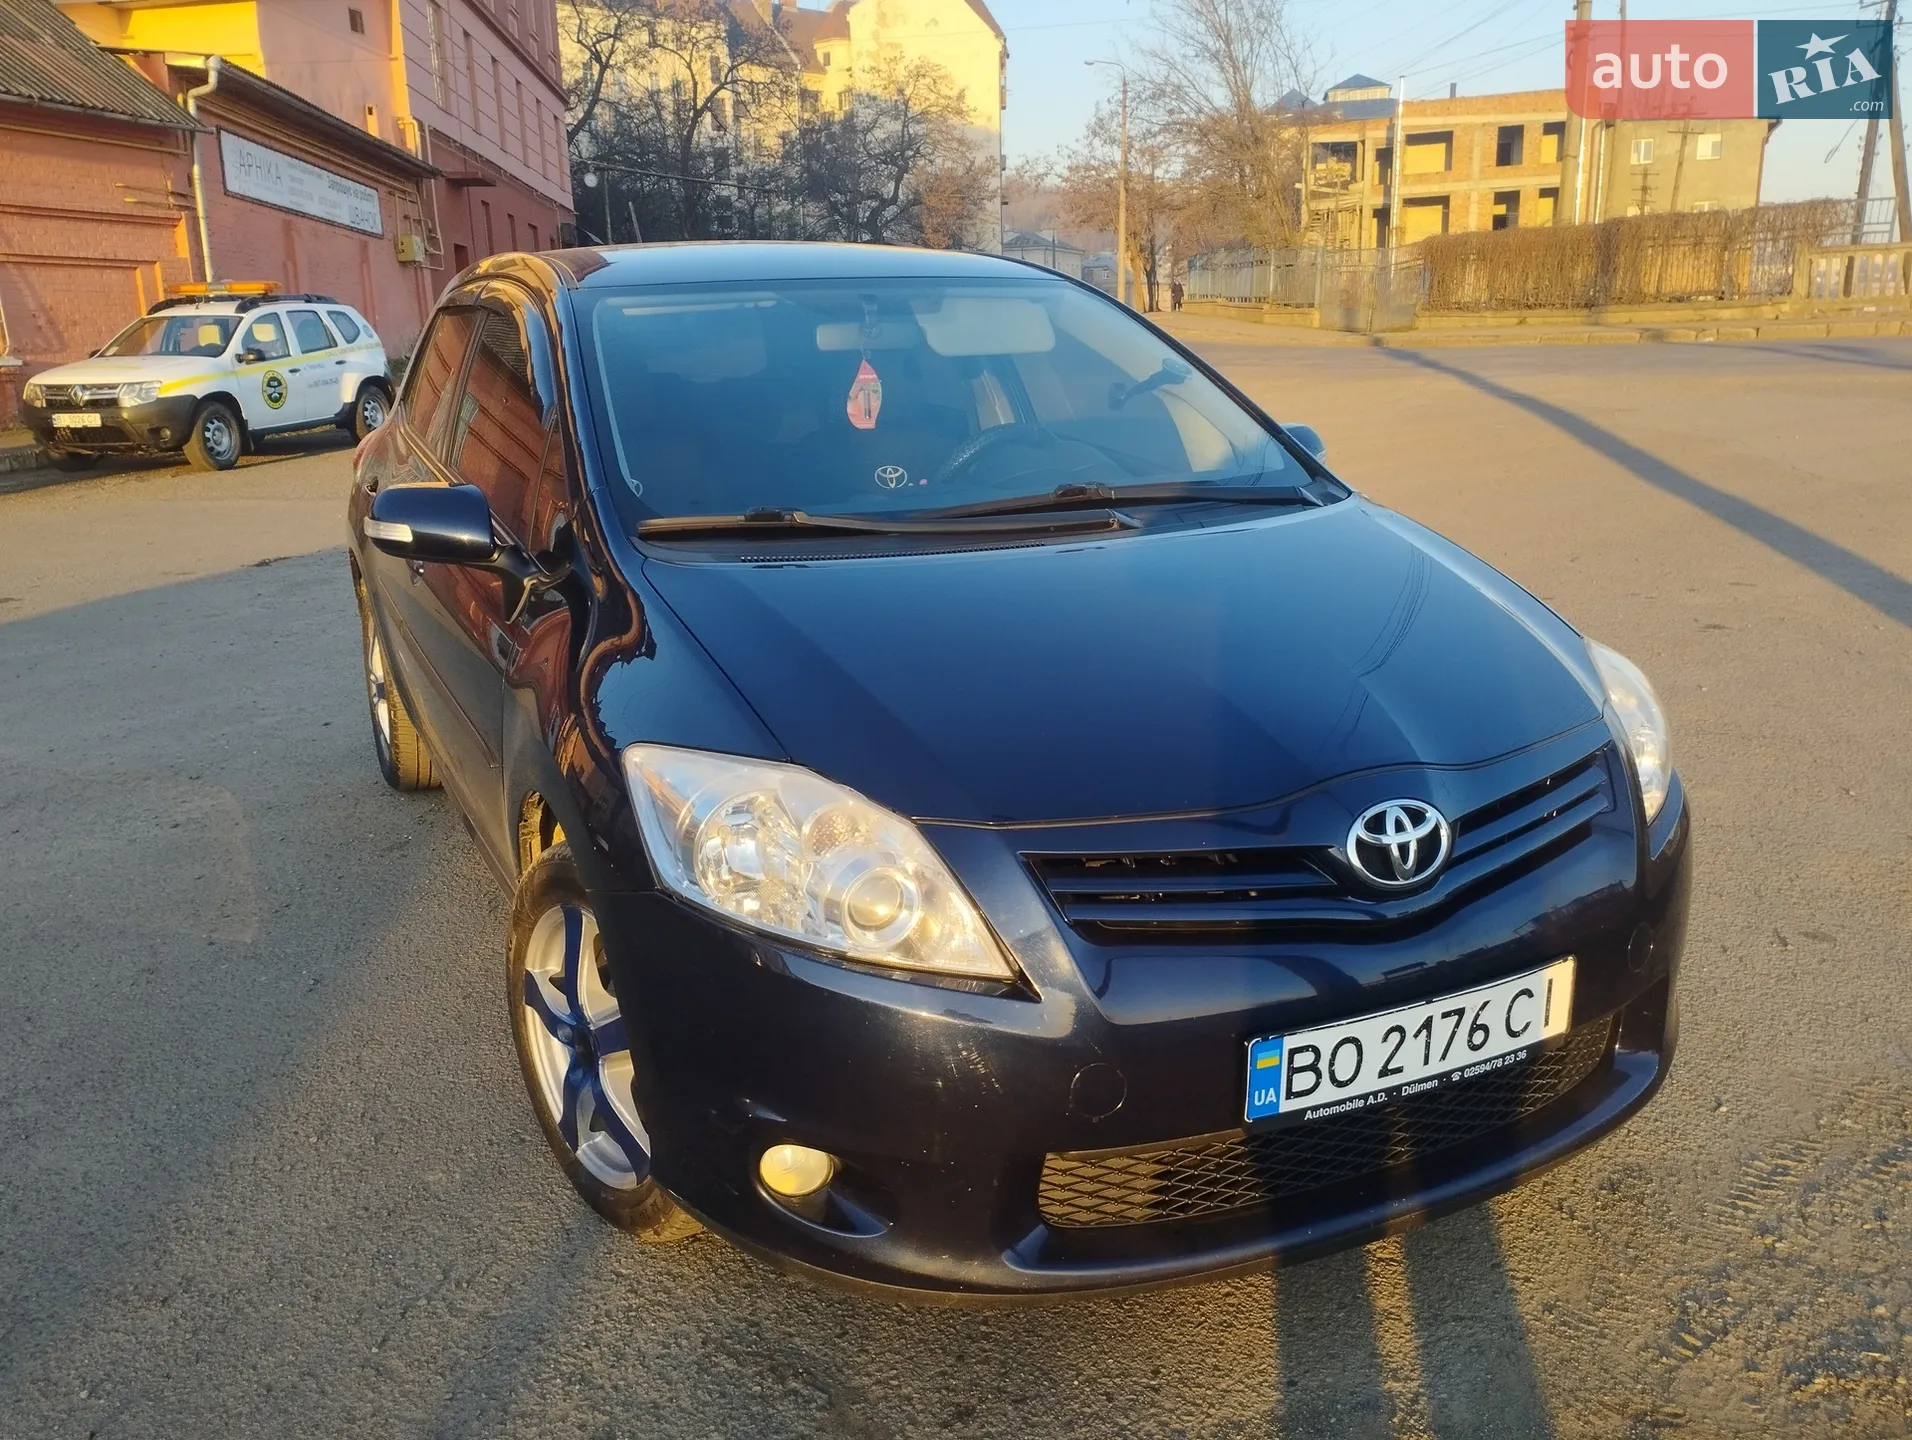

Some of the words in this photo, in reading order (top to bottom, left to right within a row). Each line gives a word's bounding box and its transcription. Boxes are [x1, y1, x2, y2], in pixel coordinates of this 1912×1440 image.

[1285, 1036, 1363, 1100] BO
[1377, 1000, 1492, 1080] 2176
[1304, 1098, 1364, 1121] Automobile
[1366, 1091, 1388, 1106] A.D.
[1401, 1078, 1438, 1096] Dülmen
[1503, 1054, 1515, 1066] 23
[1515, 1050, 1527, 1062] 36
[1254, 1087, 1277, 1106] UA
